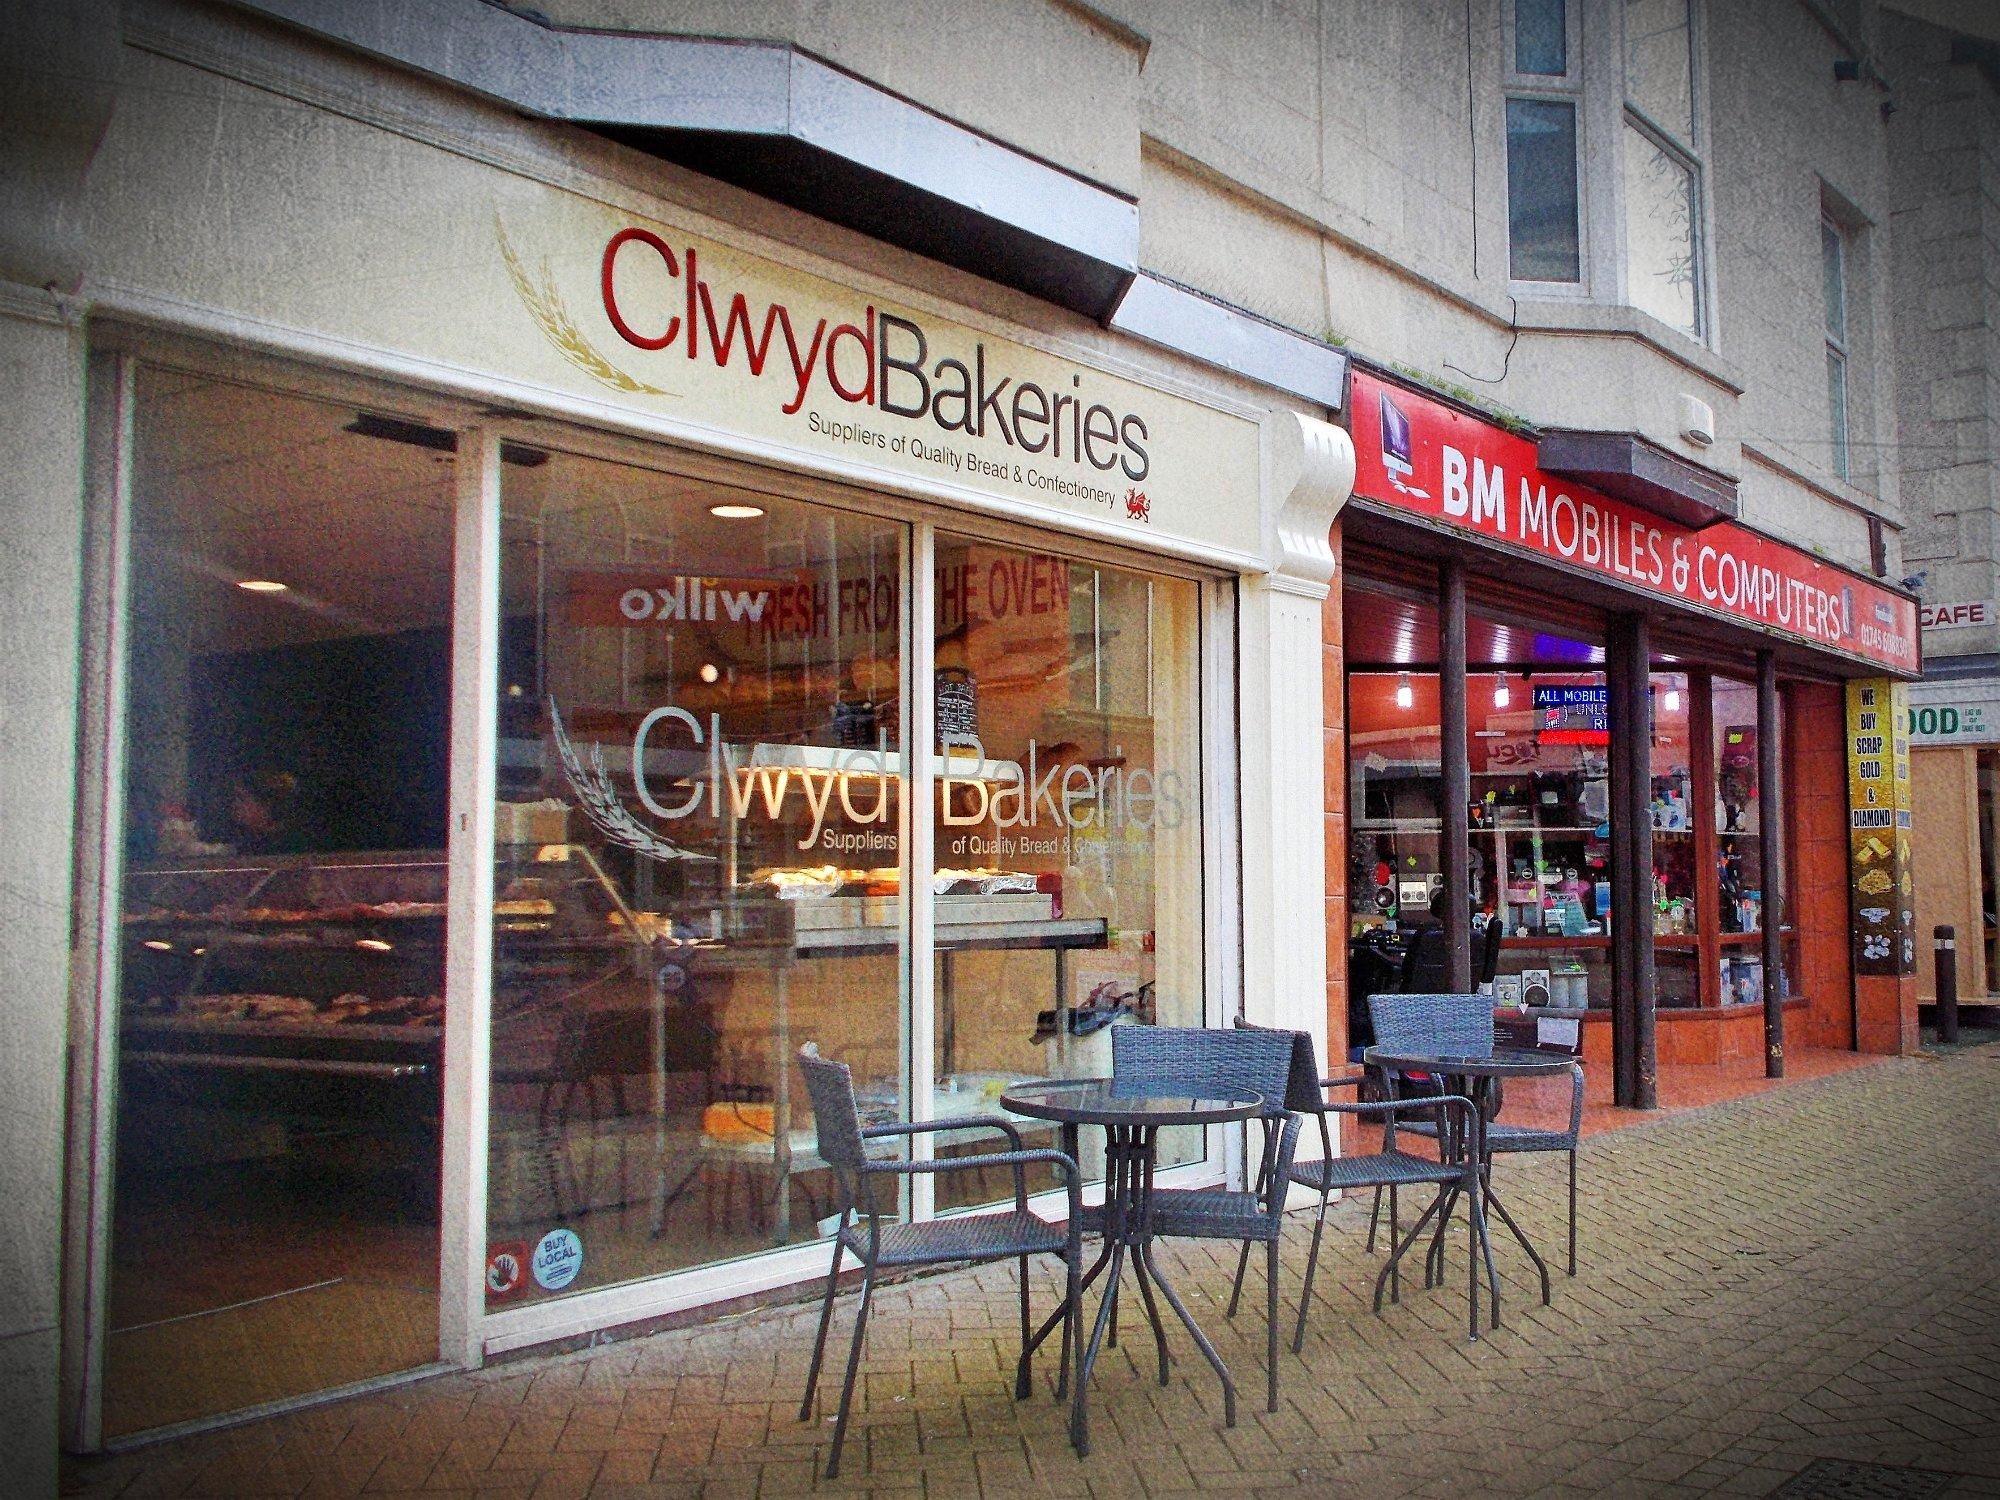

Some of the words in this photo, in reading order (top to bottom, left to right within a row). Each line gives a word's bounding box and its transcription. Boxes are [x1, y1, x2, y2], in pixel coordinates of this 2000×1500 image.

[808, 411, 887, 449] Suppliers
[890, 436, 907, 454] of
[911, 438, 963, 472] Quality
[967, 453, 1009, 480] Bread
[1013, 467, 1023, 484] &
[1027, 469, 1116, 509] Confectionery
[1442, 444, 1507, 533] BM
[1520, 476, 1664, 586] MOBILES
[1671, 536, 1690, 593] &
[1699, 545, 1841, 641] COMPUTERS
[935, 562, 979, 626] HE
[988, 554, 1070, 619] OVEN
[1920, 603, 1985, 627] CAFE
[1538, 690, 1560, 702] ALL
[1564, 690, 1607, 702] MOBILE
[1860, 688, 1875, 706] WE
[1860, 713, 1876, 730] BUY
[1856, 736, 1883, 755] SCRAP
[634, 706, 888, 850] Clwyd
[942, 731, 1183, 829] Bakeries
[1859, 761, 1881, 779] GOLD
[1853, 809, 1891, 828] DIAMOND
[823, 828, 898, 853] Suppliers
[952, 836, 966, 855] of
[969, 836, 1017, 858] Quality
[1020, 836, 1058, 855] Bread
[544, 1233, 568, 1252] BUY
[538, 1246, 577, 1268] LOCAL
